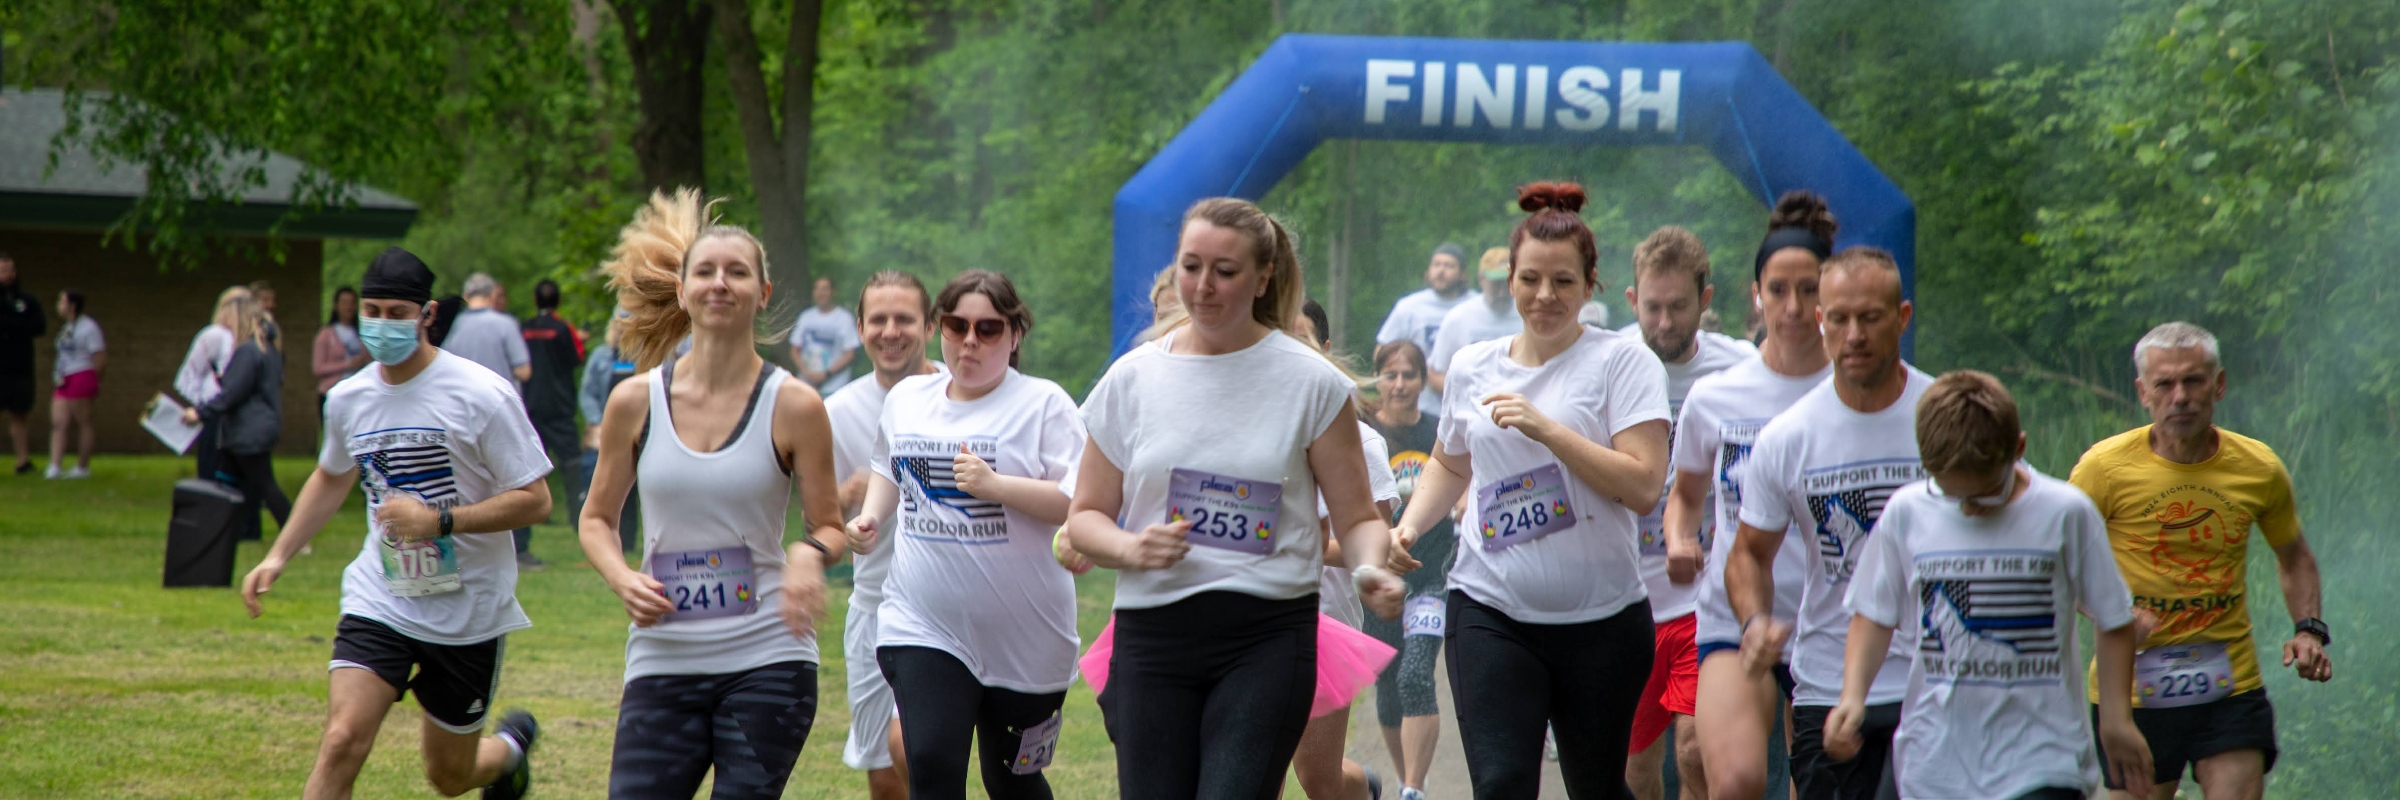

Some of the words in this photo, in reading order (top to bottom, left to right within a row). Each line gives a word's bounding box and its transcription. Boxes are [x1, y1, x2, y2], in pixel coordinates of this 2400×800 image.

[1364, 59, 1682, 134] FINISH
[399, 433, 418, 443] THE
[894, 440, 942, 452] SUPPORT
[947, 441, 963, 453] TH
[1811, 467, 1878, 488] SUPPORT
[1883, 465, 1911, 478] THE
[1208, 498, 1222, 506] THE
[2160, 484, 2197, 499] EIGHTH
[2199, 485, 2236, 512] ANNUAL
[919, 519, 969, 536] COLOR
[972, 521, 1008, 537] RUN
[1190, 507, 1248, 541] 253
[1499, 501, 1549, 538] 248
[391, 546, 438, 579] 176
[1917, 558, 1986, 575] SUPPORT
[1993, 558, 2023, 571] THE
[675, 582, 726, 611] 241
[1410, 615, 1441, 629] 249
[1949, 659, 2012, 678] COLOR
[2018, 658, 2060, 677] RUN
[2160, 672, 2210, 698] 229
